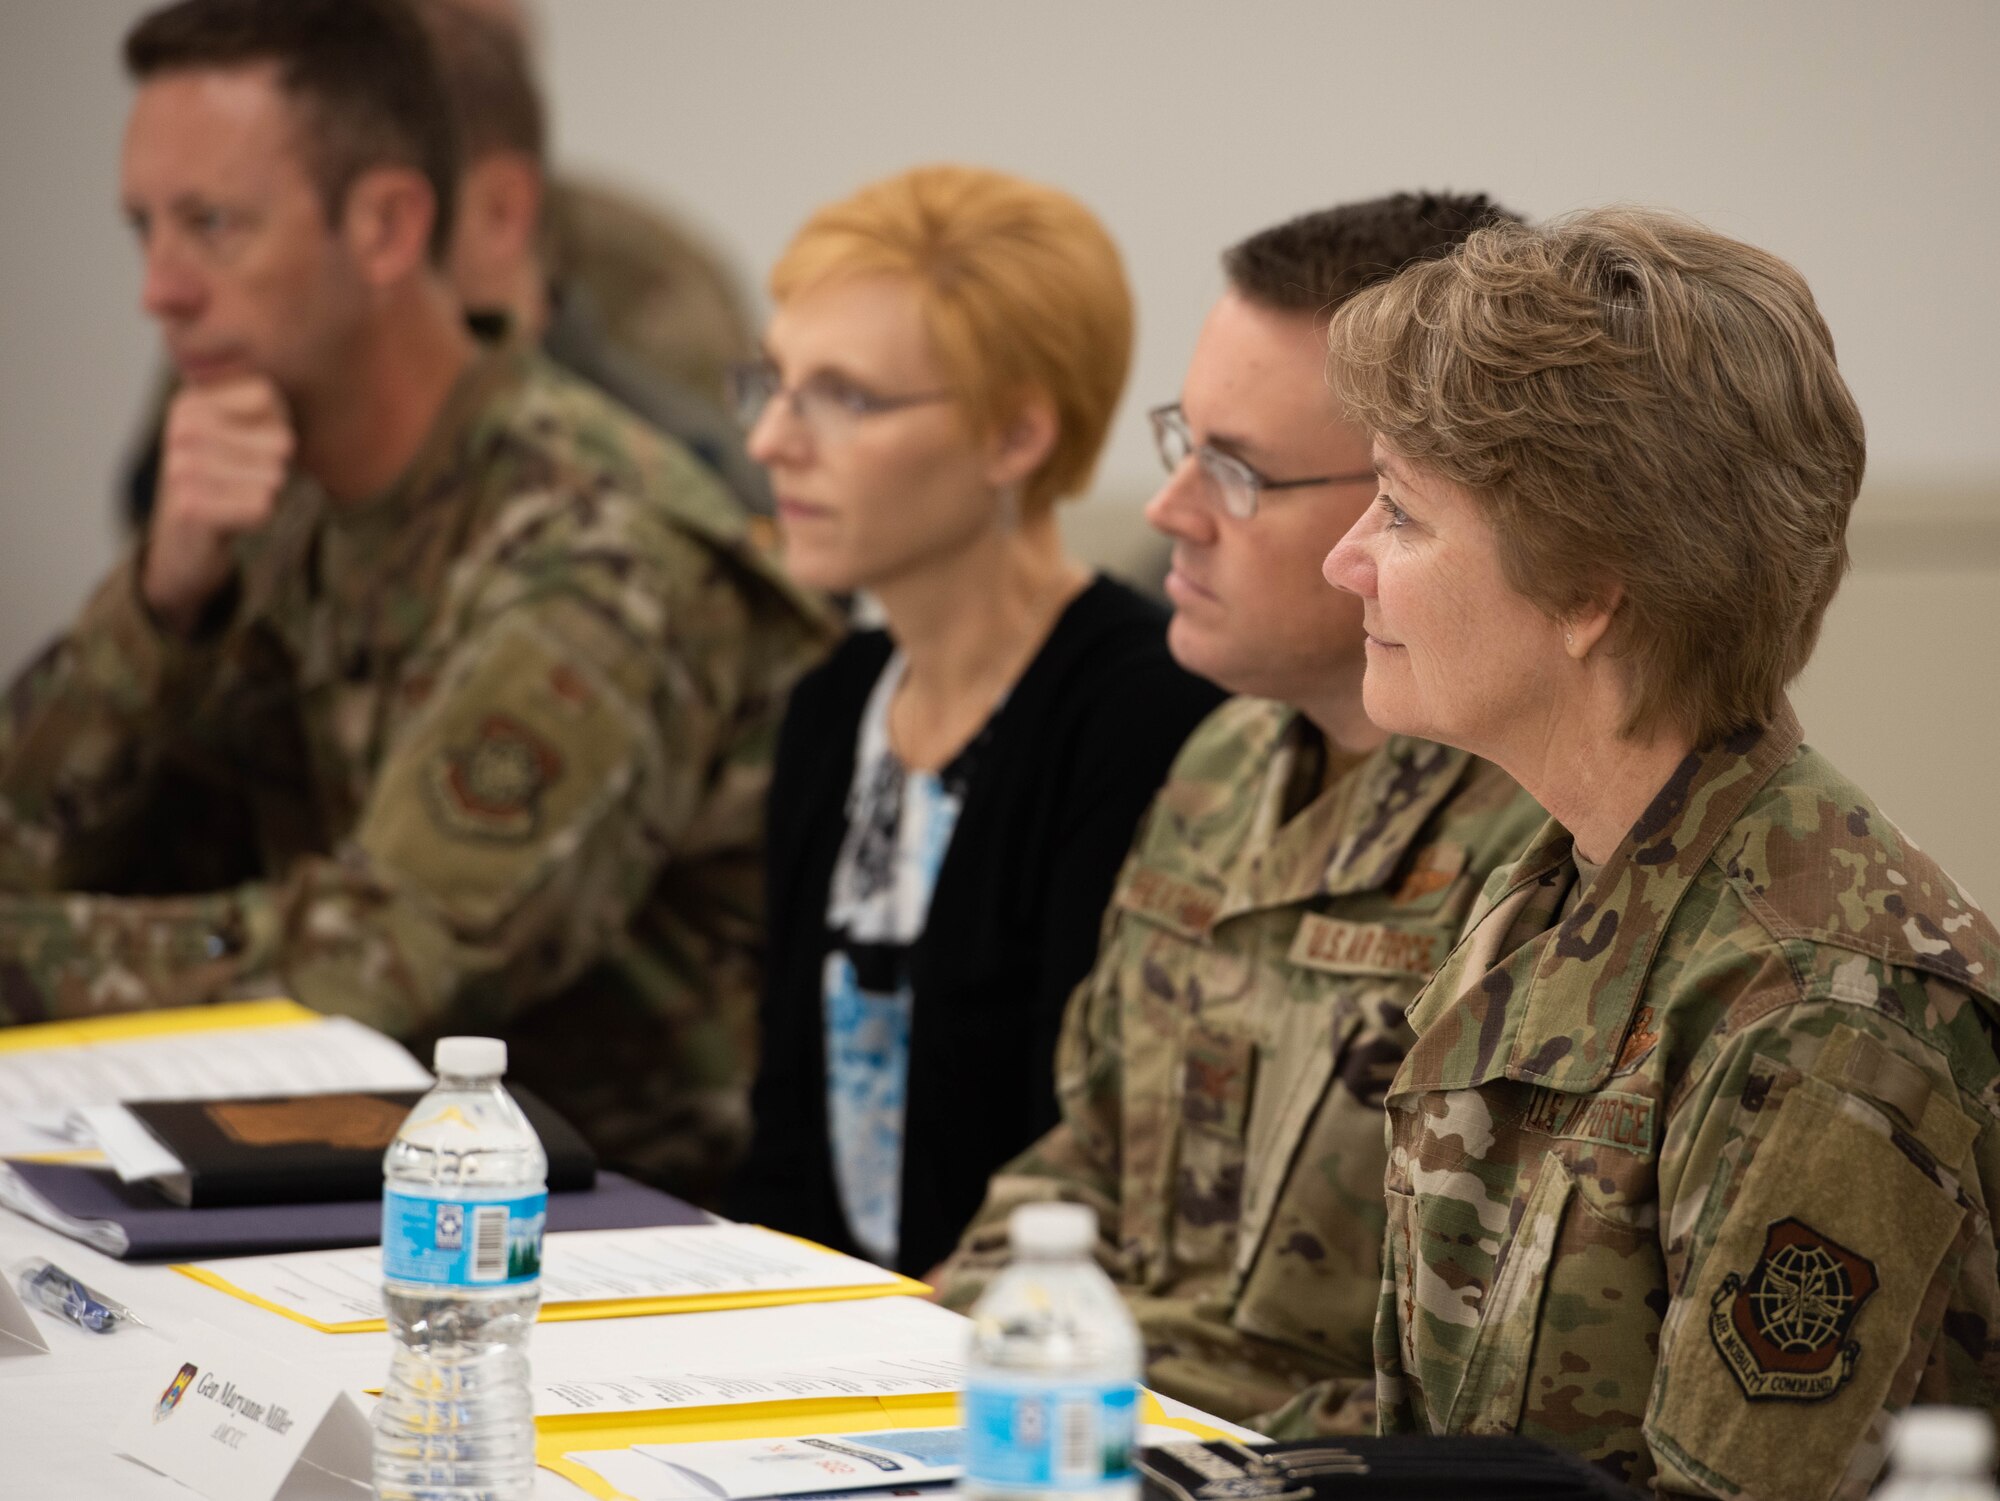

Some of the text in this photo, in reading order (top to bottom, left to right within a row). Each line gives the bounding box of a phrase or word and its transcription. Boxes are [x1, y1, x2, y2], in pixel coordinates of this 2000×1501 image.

[1713, 1313, 1834, 1392] AIR MOBILITY COMMAND
[196, 1371, 294, 1436] Gen Maryanne Miller
